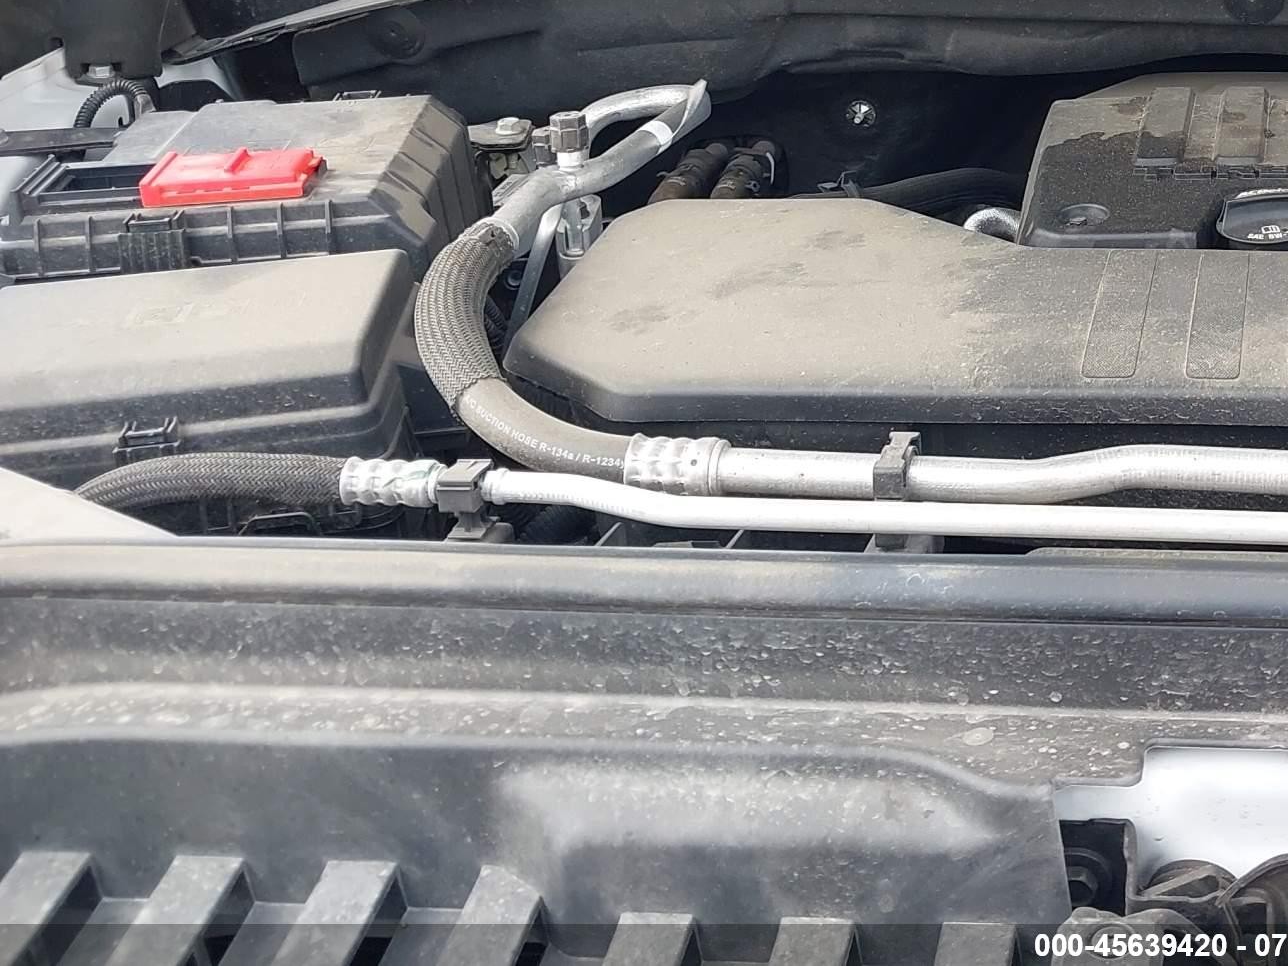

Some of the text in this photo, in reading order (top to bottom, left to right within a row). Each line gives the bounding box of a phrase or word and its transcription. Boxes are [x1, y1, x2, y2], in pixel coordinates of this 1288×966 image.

[475, 406, 511, 434] SUCTION
[511, 429, 538, 449] HOSE
[539, 441, 574, 461] R-134a
